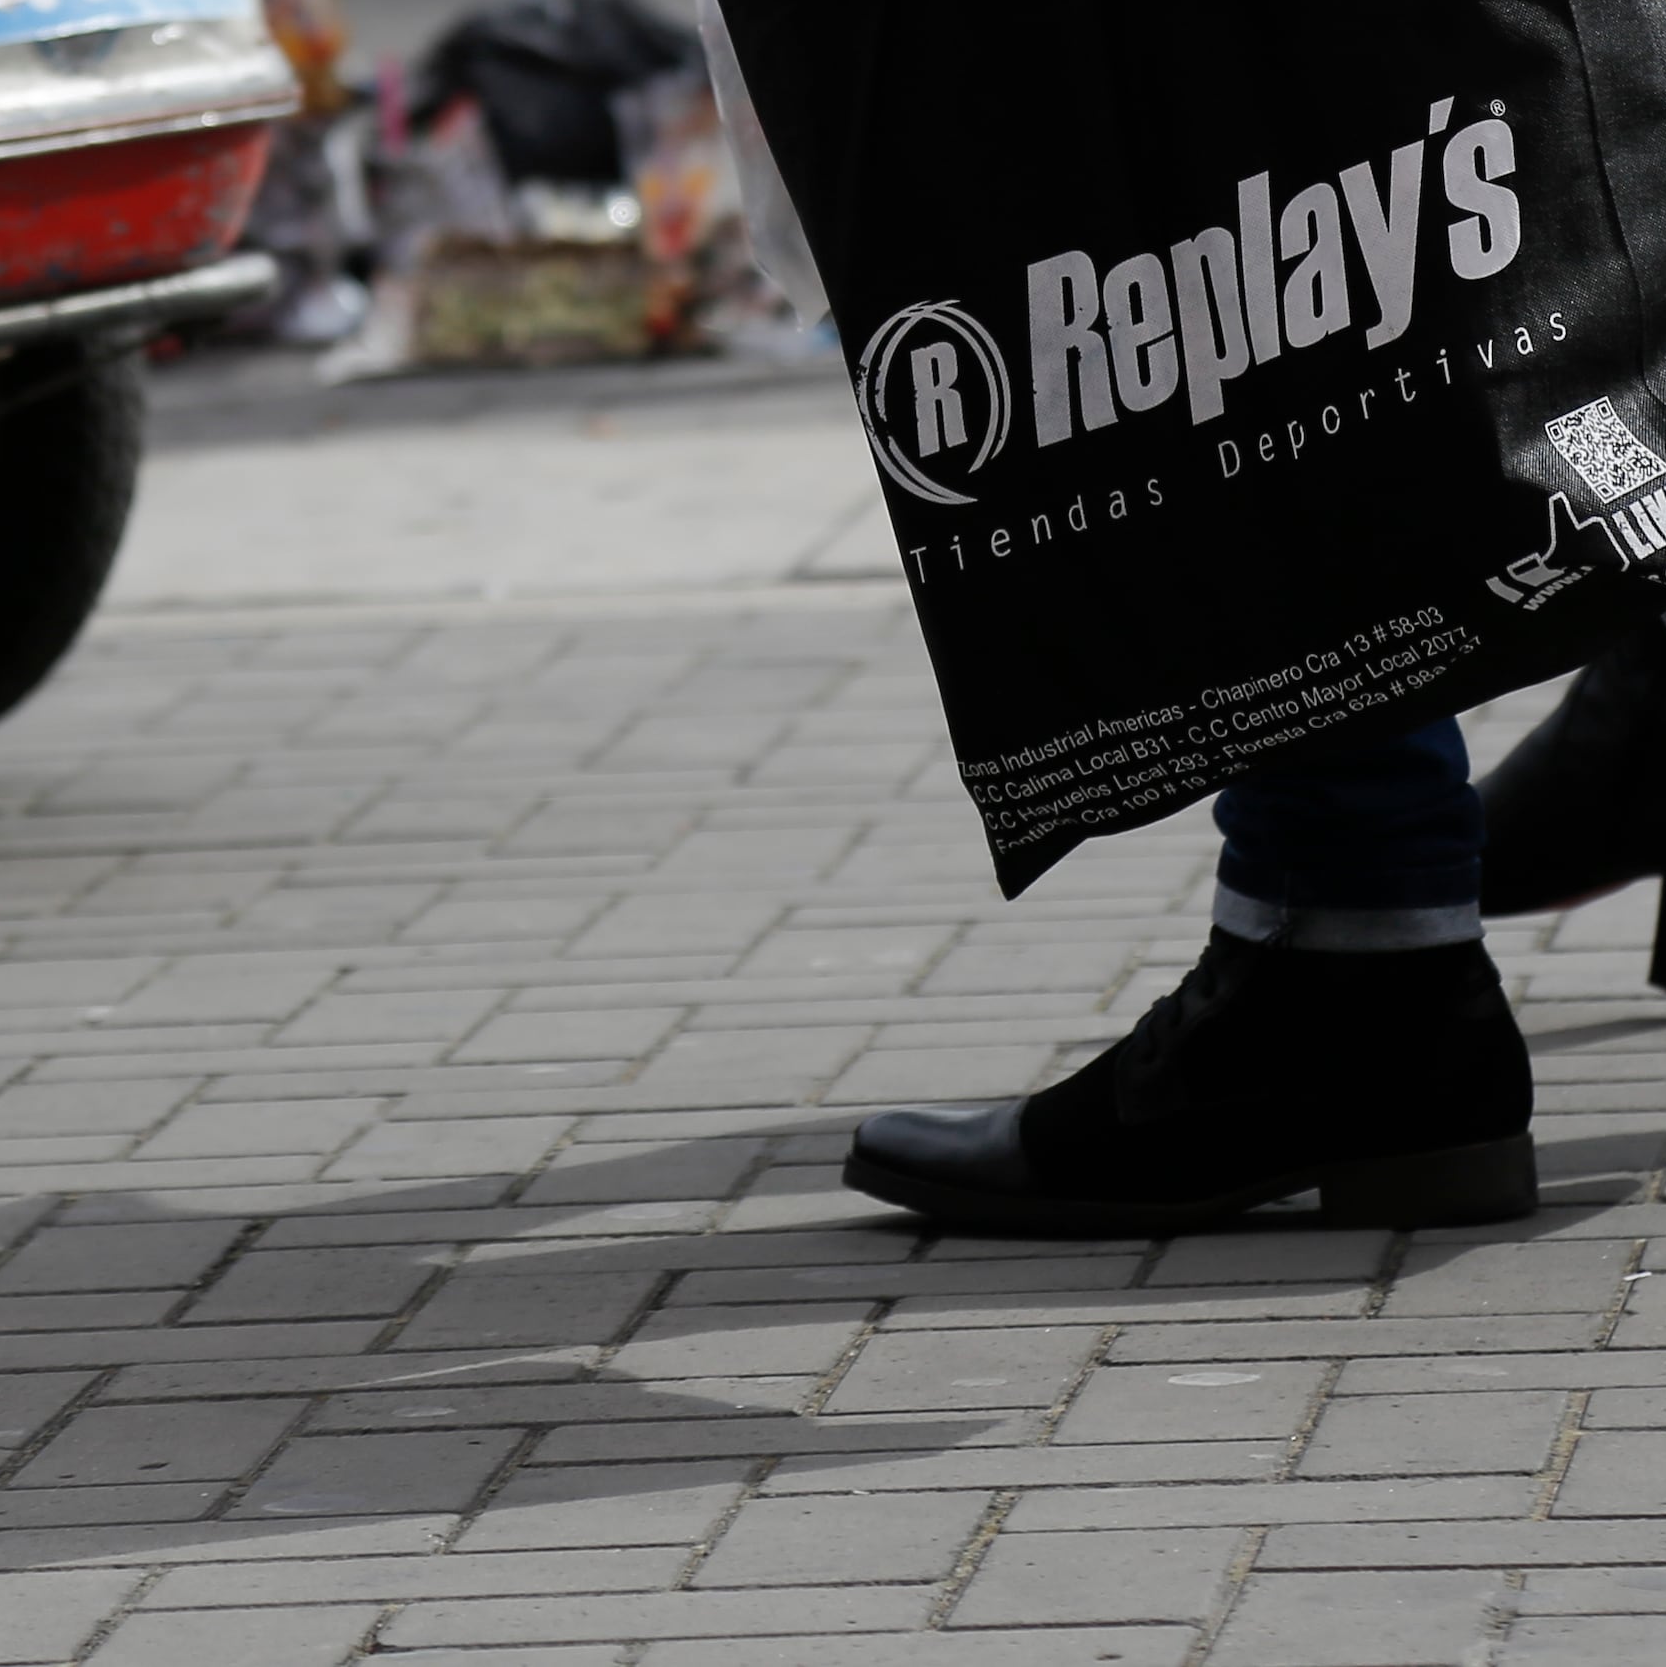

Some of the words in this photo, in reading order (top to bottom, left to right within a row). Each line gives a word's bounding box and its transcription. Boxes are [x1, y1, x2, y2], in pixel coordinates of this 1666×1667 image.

[1027, 95, 1521, 448] Replay's
[909, 478, 1164, 584] Tiendas
[1217, 311, 1568, 478] Deportivas
[957, 761, 999, 778] Zona
[1001, 724, 1094, 771] Industrial
[1097, 704, 1185, 738] Americas
[1201, 665, 1304, 710] Chapinero
[1305, 651, 1341, 674] Cra
[1343, 633, 1371, 658] 13
[1372, 623, 1388, 644] #
[1389, 606, 1445, 638] 58-03
[1005, 767, 1074, 800] Calima
[1075, 744, 1130, 776] Local
[1130, 735, 1172, 759] B31
[1188, 718, 1228, 744] C.C
[1232, 701, 1300, 732] Centro
[1301, 671, 1364, 710] Mayor
[1365, 644, 1422, 679] Local
[1420, 626, 1469, 657] 2077
[1017, 782, 1113, 822] Hayuelos
[1115, 763, 1169, 791] Local
[1168, 752, 1209, 774] 293
[1222, 723, 1307, 760] Floresta
[1308, 708, 1348, 730] Cra
[1348, 692, 1389, 713] 62a
[1389, 680, 1406, 698] #
[1081, 806, 1121, 825] Cra
[1122, 786, 1161, 811] 100
